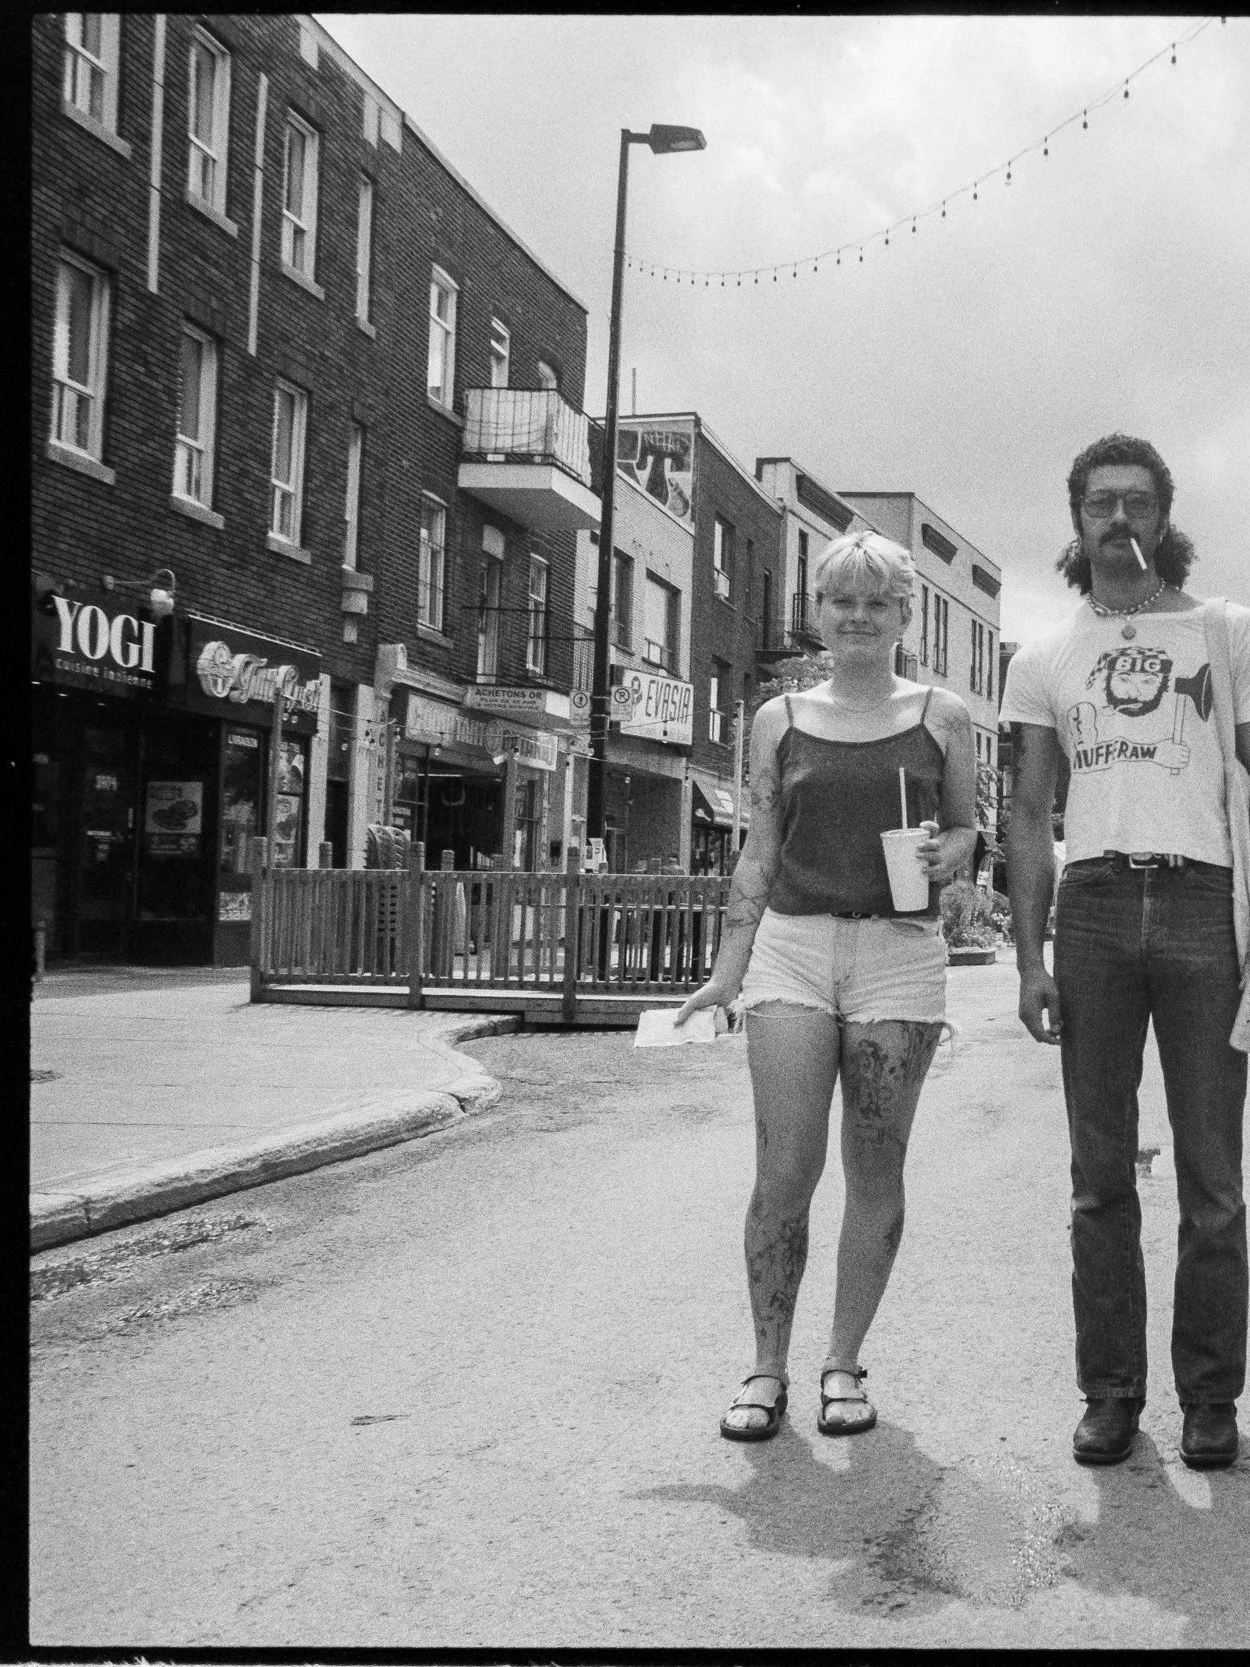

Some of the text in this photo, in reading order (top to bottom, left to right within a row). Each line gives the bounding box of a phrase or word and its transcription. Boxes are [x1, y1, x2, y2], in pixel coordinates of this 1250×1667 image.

[51, 595, 157, 673] YOGI
[1115, 657, 1161, 673] BIG
[475, 688, 543, 701] ACHETONS OR
[644, 679, 692, 725] EVASIA
